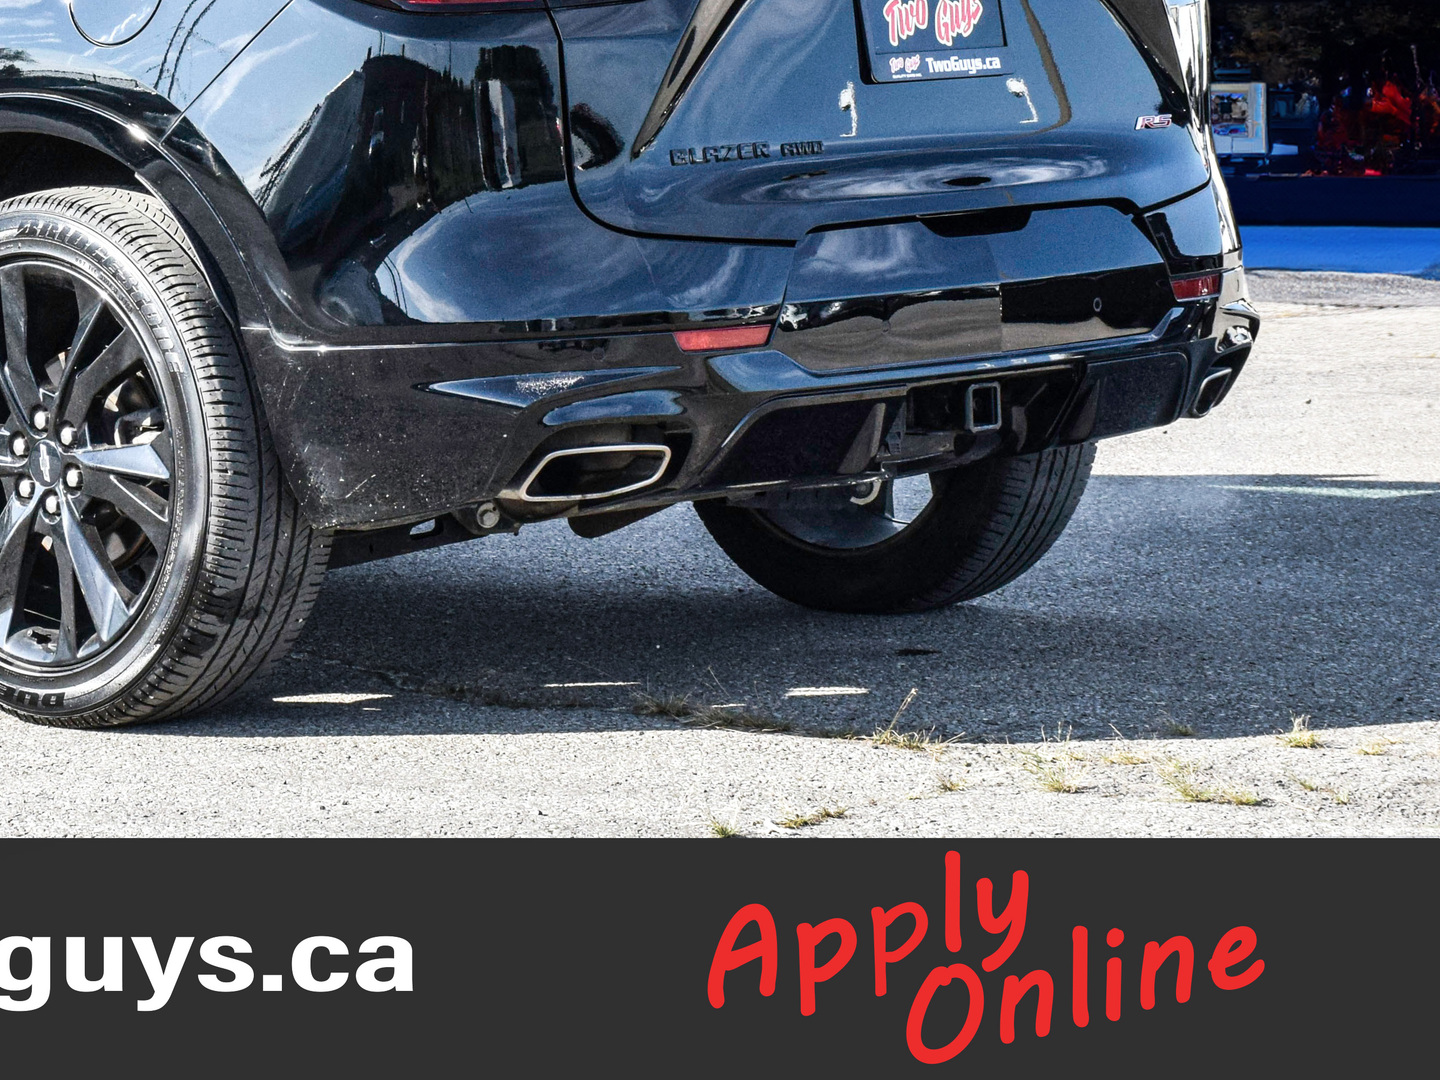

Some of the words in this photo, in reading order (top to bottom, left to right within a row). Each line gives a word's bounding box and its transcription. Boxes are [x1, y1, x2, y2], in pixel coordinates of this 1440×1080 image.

[925, 56, 1001, 74] TwoGuys.ca
[1134, 114, 1172, 130] RS
[669, 141, 771, 166] BLAZER
[780, 140, 825, 157] AWD
